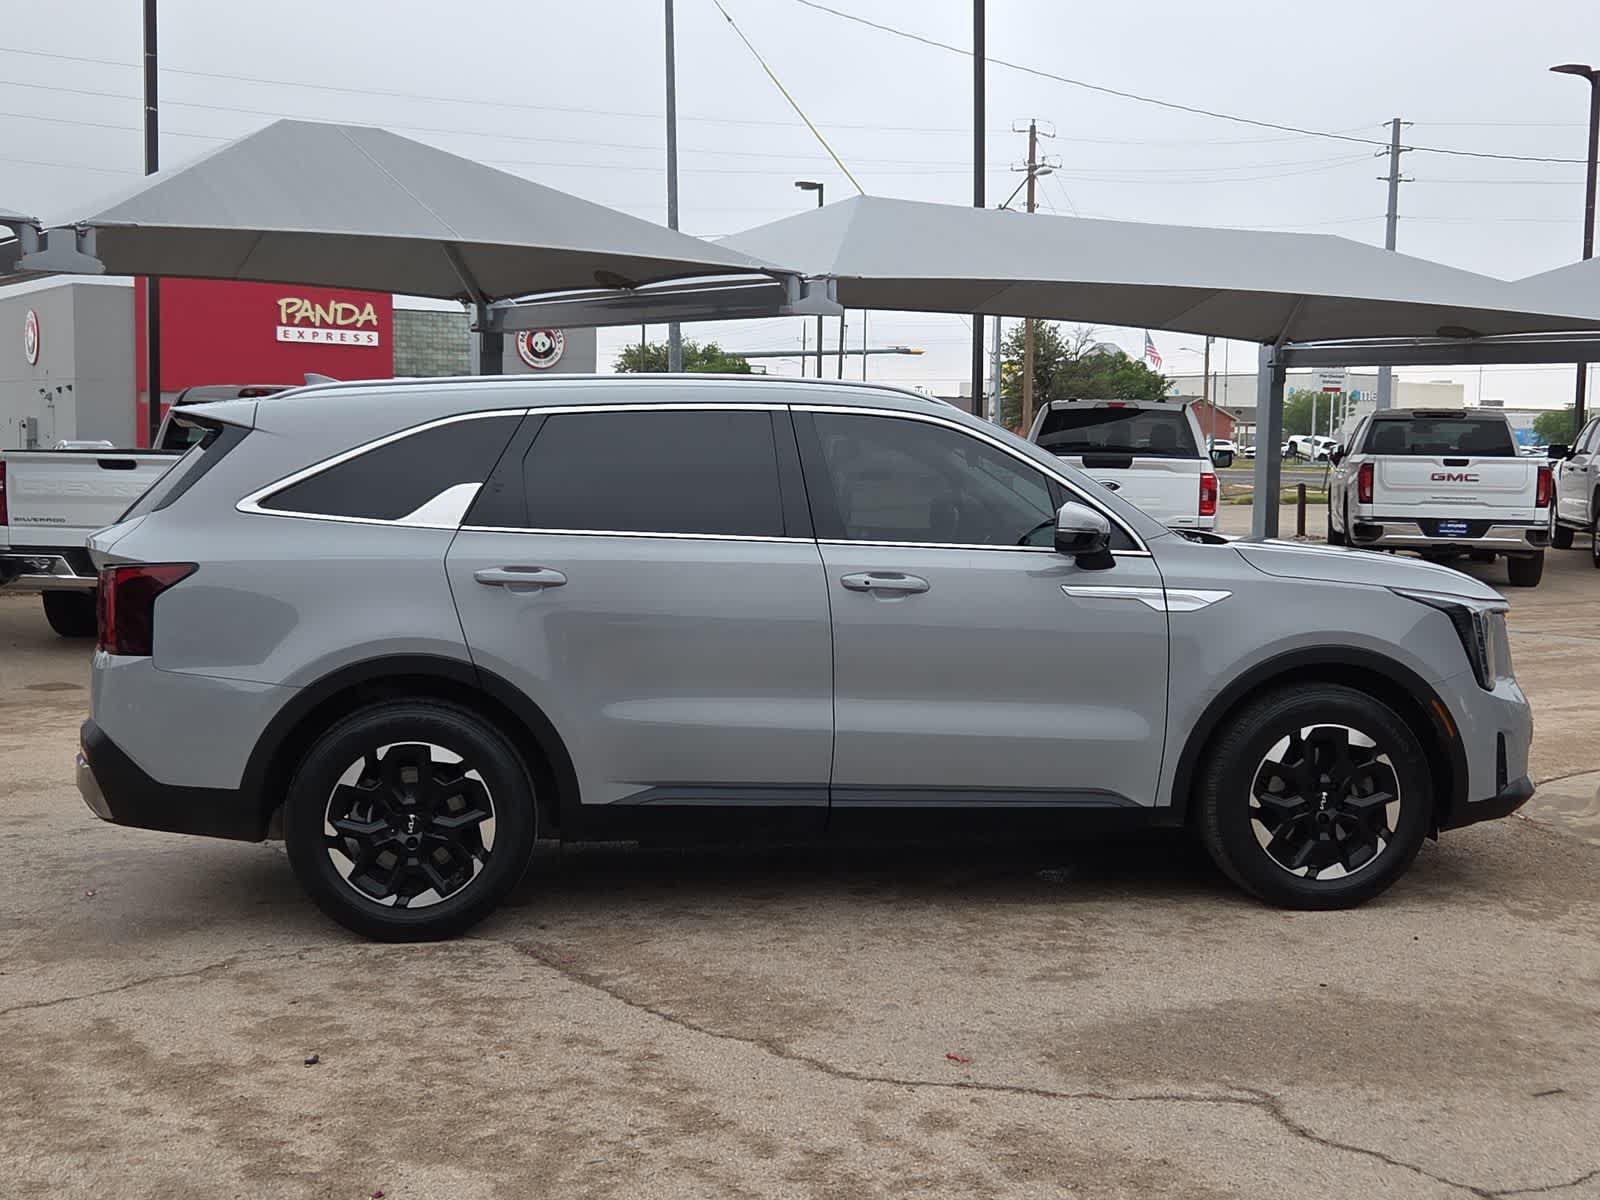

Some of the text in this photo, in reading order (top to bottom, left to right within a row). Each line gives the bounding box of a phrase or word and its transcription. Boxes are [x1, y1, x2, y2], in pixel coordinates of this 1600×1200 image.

[277, 297, 378, 328] PANDA
[282, 330, 375, 344] EXPRESS
[1430, 473, 1480, 482] GMC
